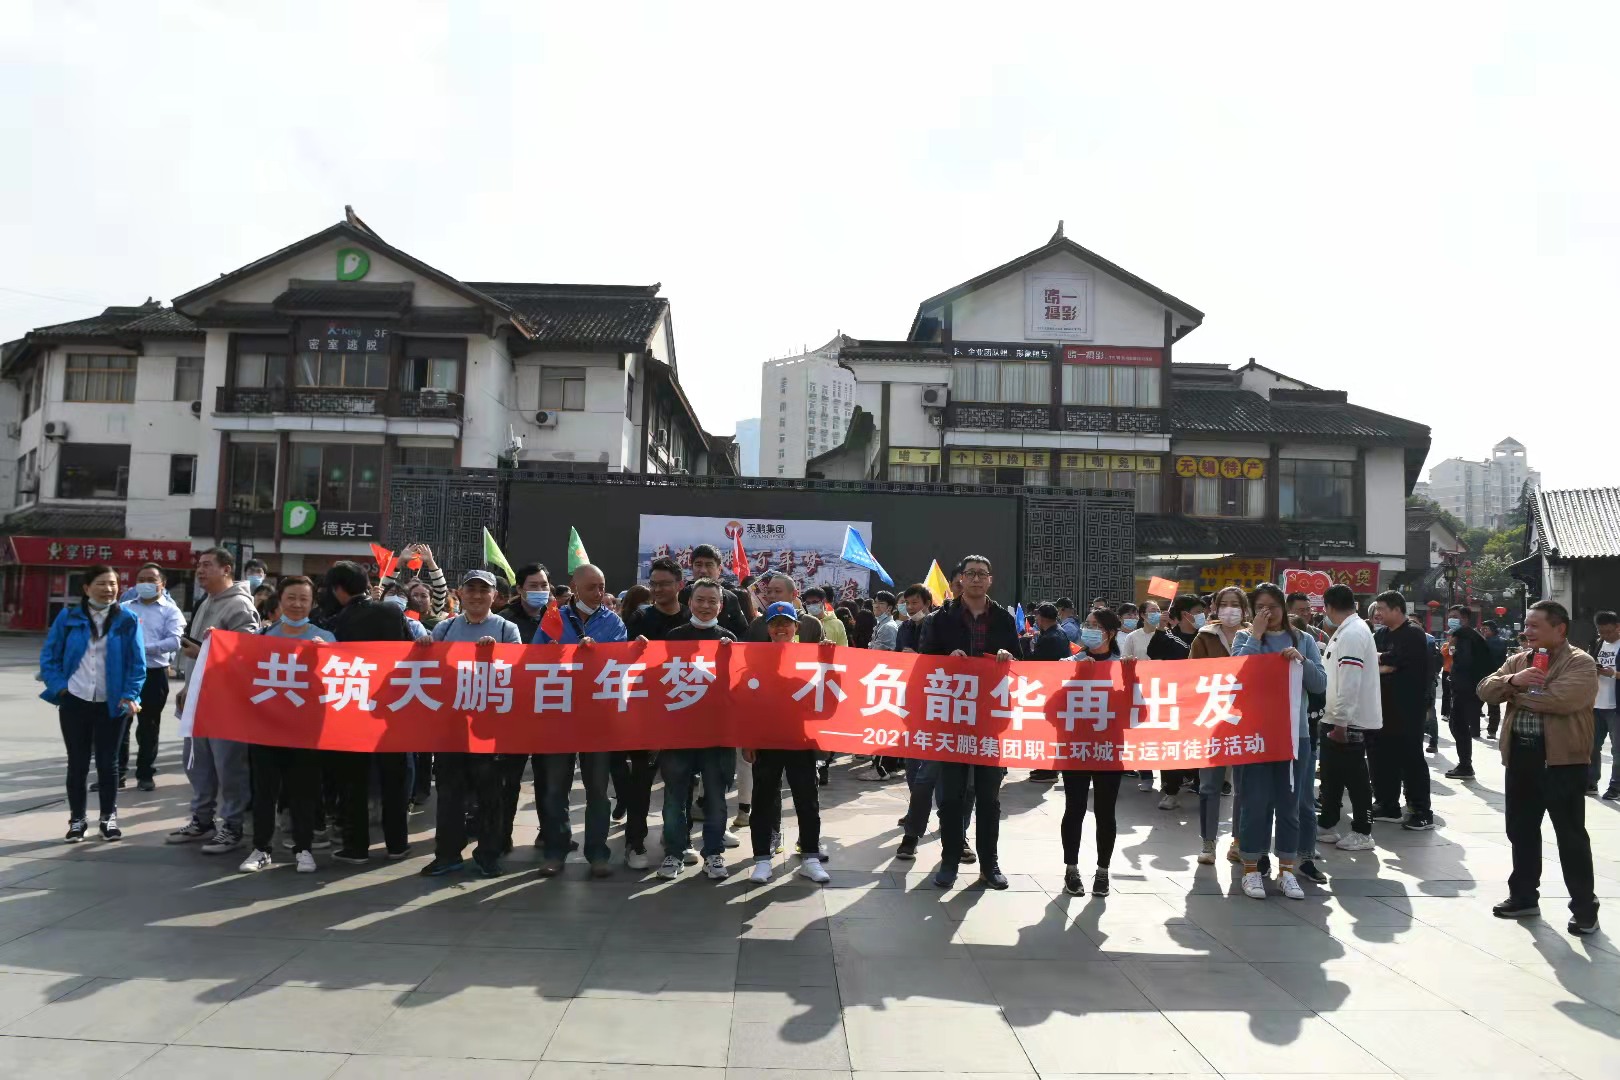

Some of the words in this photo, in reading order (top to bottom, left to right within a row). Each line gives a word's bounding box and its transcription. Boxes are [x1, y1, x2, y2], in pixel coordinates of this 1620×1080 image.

[1044, 305, 1077, 321] 摄影
[308, 339, 377, 350] 密室逃脱
[1180, 459, 1260, 476] 无锡特产
[322, 521, 374, 537] 德克士
[747, 523, 785, 533] 天鹏集团
[123, 549, 177, 561] 中式快餐
[650, 545, 824, 576] 共筑百年梦
